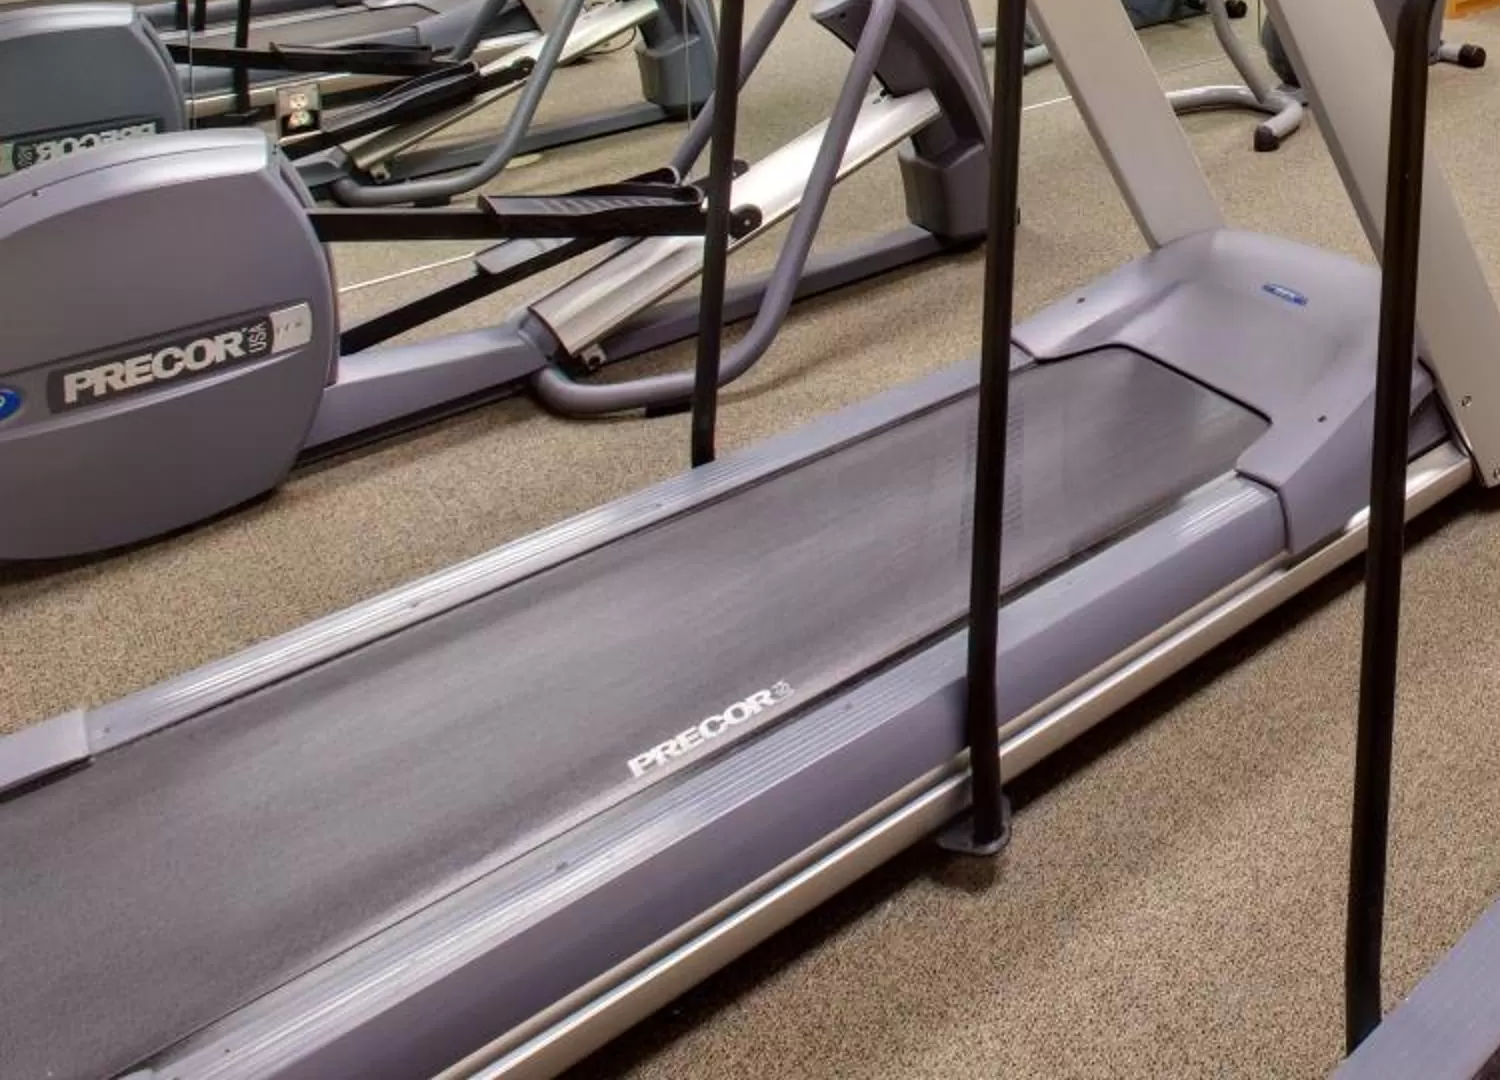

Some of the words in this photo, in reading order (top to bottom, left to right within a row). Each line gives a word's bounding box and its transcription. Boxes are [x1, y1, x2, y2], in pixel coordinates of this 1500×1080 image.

[63, 330, 246, 404] PRECOR
[248, 320, 268, 353] USA
[627, 688, 776, 778] PRECOR
